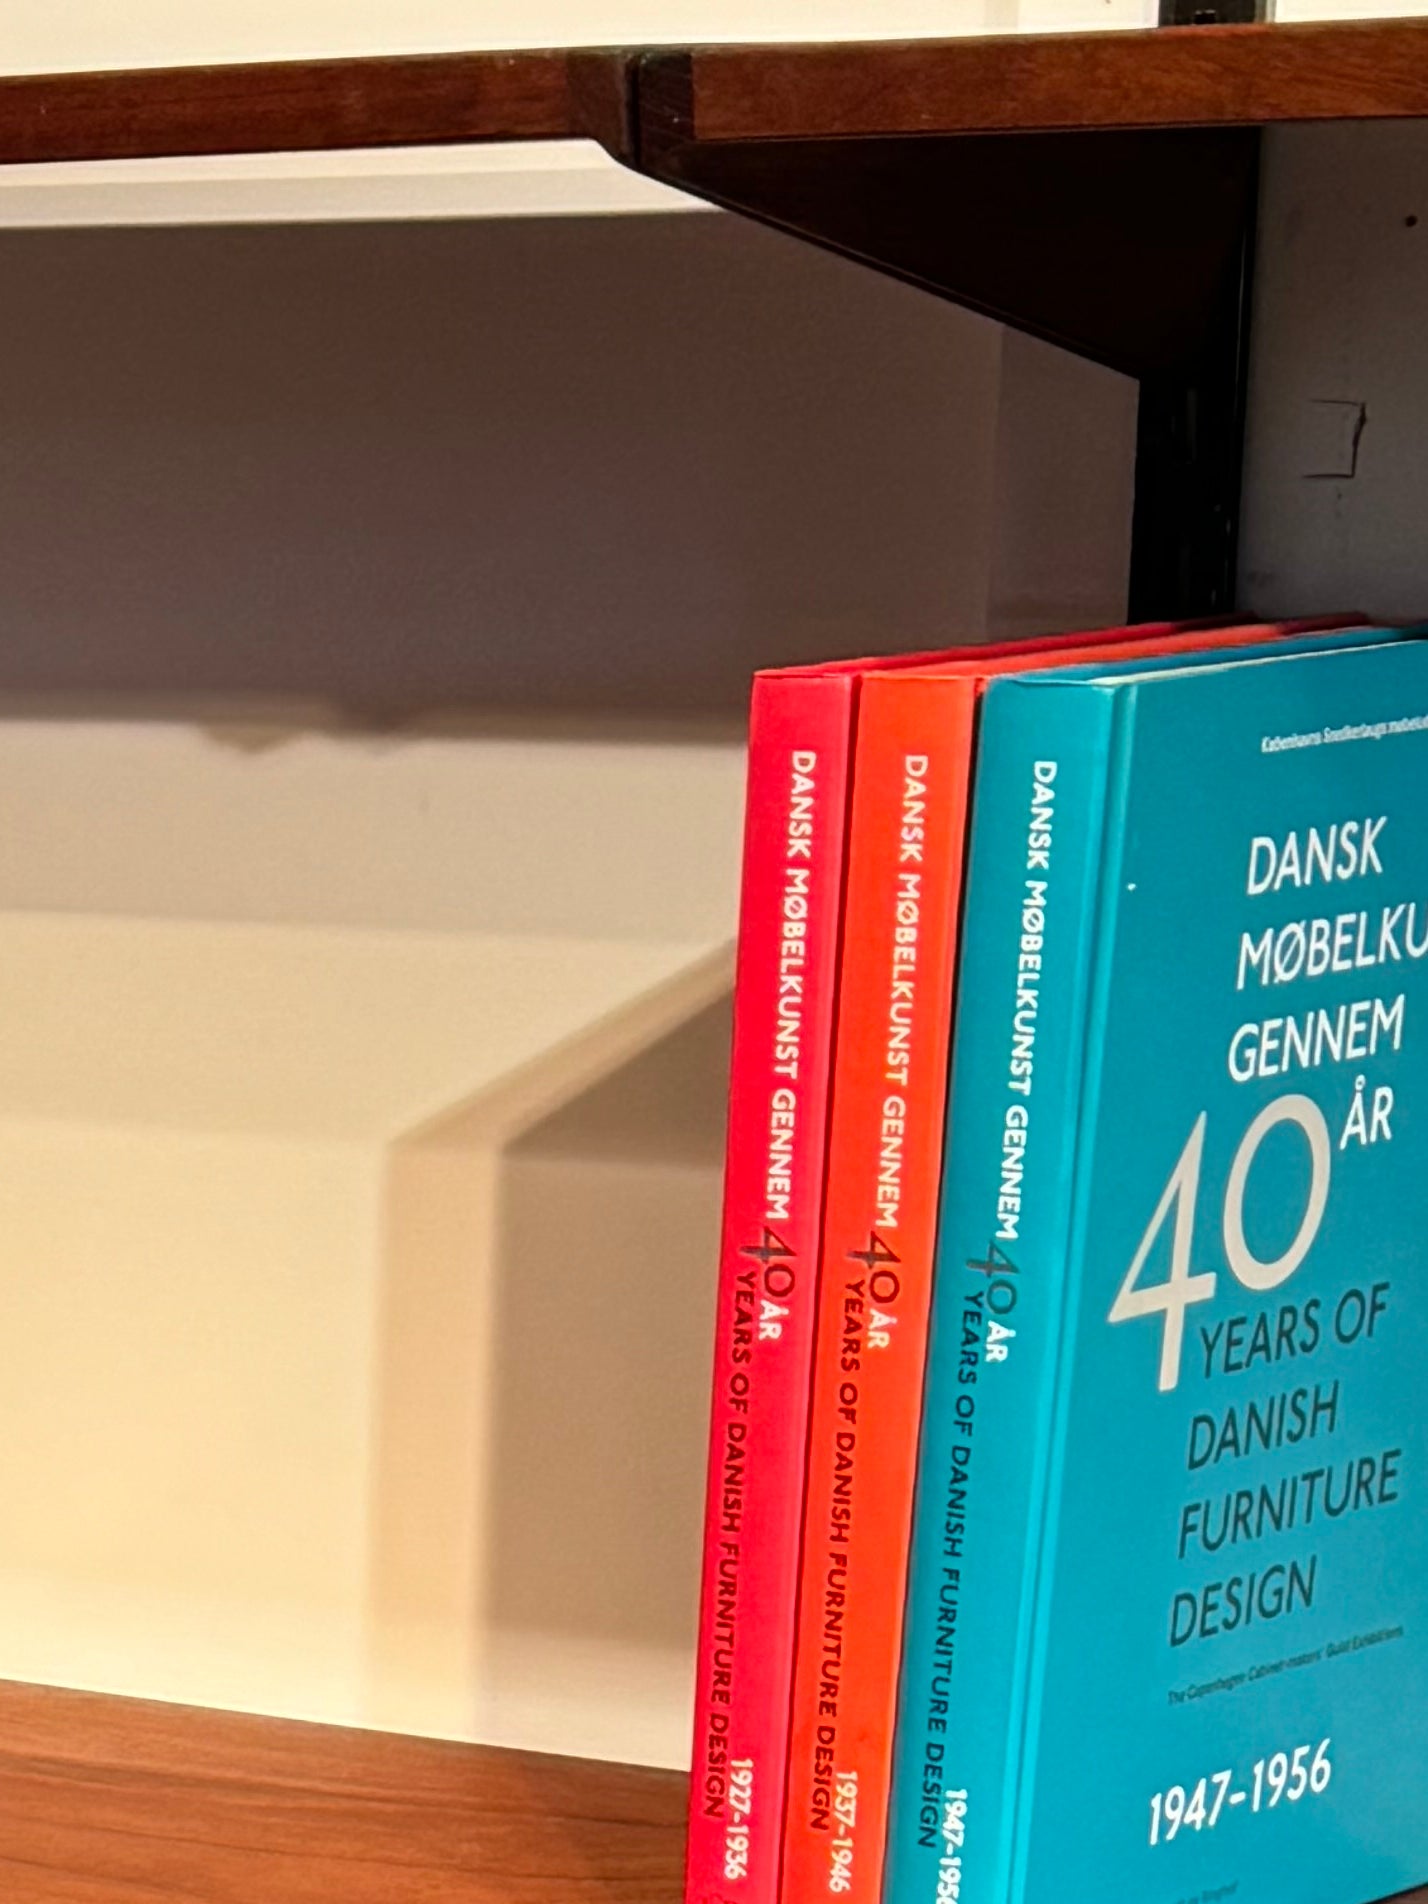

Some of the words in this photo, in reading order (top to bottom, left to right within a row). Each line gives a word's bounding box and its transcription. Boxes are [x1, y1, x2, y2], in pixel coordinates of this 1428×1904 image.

[787, 750, 817, 859] DANSK
[899, 754, 928, 863] DANSK
[1026, 760, 1058, 871] DANSK
[1246, 815, 1388, 896] DANSK
[772, 868, 809, 1080] MØBELKUNST
[885, 872, 921, 1087] MØBELKUNST
[1007, 879, 1048, 1097] MØBELKUNST
[1235, 902, 1428, 991] MØBELKU
[1227, 993, 1406, 1083] GENNEM
[765, 1087, 796, 1221] GENNEM
[875, 1095, 906, 1228] GENNEM
[1339, 1074, 1393, 1150] ÅR
[995, 1104, 1029, 1240] GENNEM
[738, 1226, 797, 1299] 40
[846, 1230, 902, 1304] 40
[965, 1238, 1022, 1316] 40
[1106, 1093, 1332, 1392] 40
[730, 1271, 757, 1365] YEARS
[758, 1299, 789, 1341] ÅR
[839, 1279, 865, 1372] YEARS
[867, 1308, 897, 1349] ÅR
[957, 1290, 986, 1386] YEARS
[984, 1319, 1017, 1364] ÅR
[1200, 1297, 1322, 1380] YEARS
[1334, 1281, 1391, 1345] OF
[727, 1372, 751, 1415] OF
[838, 1383, 858, 1425] OF
[952, 1394, 976, 1438] OF
[1187, 1379, 1340, 1471] DANISH
[720, 1422, 747, 1534] DANISH
[829, 1431, 857, 1544] DANISH
[943, 1445, 972, 1558] DANISH
[1177, 1447, 1402, 1561] FURNITURE
[710, 1541, 741, 1706] FURNITURE
[818, 1551, 848, 1719] FURNITURE
[927, 1566, 961, 1733] FURNITURE
[1168, 1553, 1318, 1648] DESIGN
[703, 1713, 729, 1819] DESIGN
[810, 1725, 837, 1831] DESIGN
[917, 1743, 945, 1848] DESIGN
[1149, 1737, 1332, 1846] 1947-1956
[724, 1758, 754, 1881] 1927-1936
[828, 1770, 859, 1894] 1937-1946
